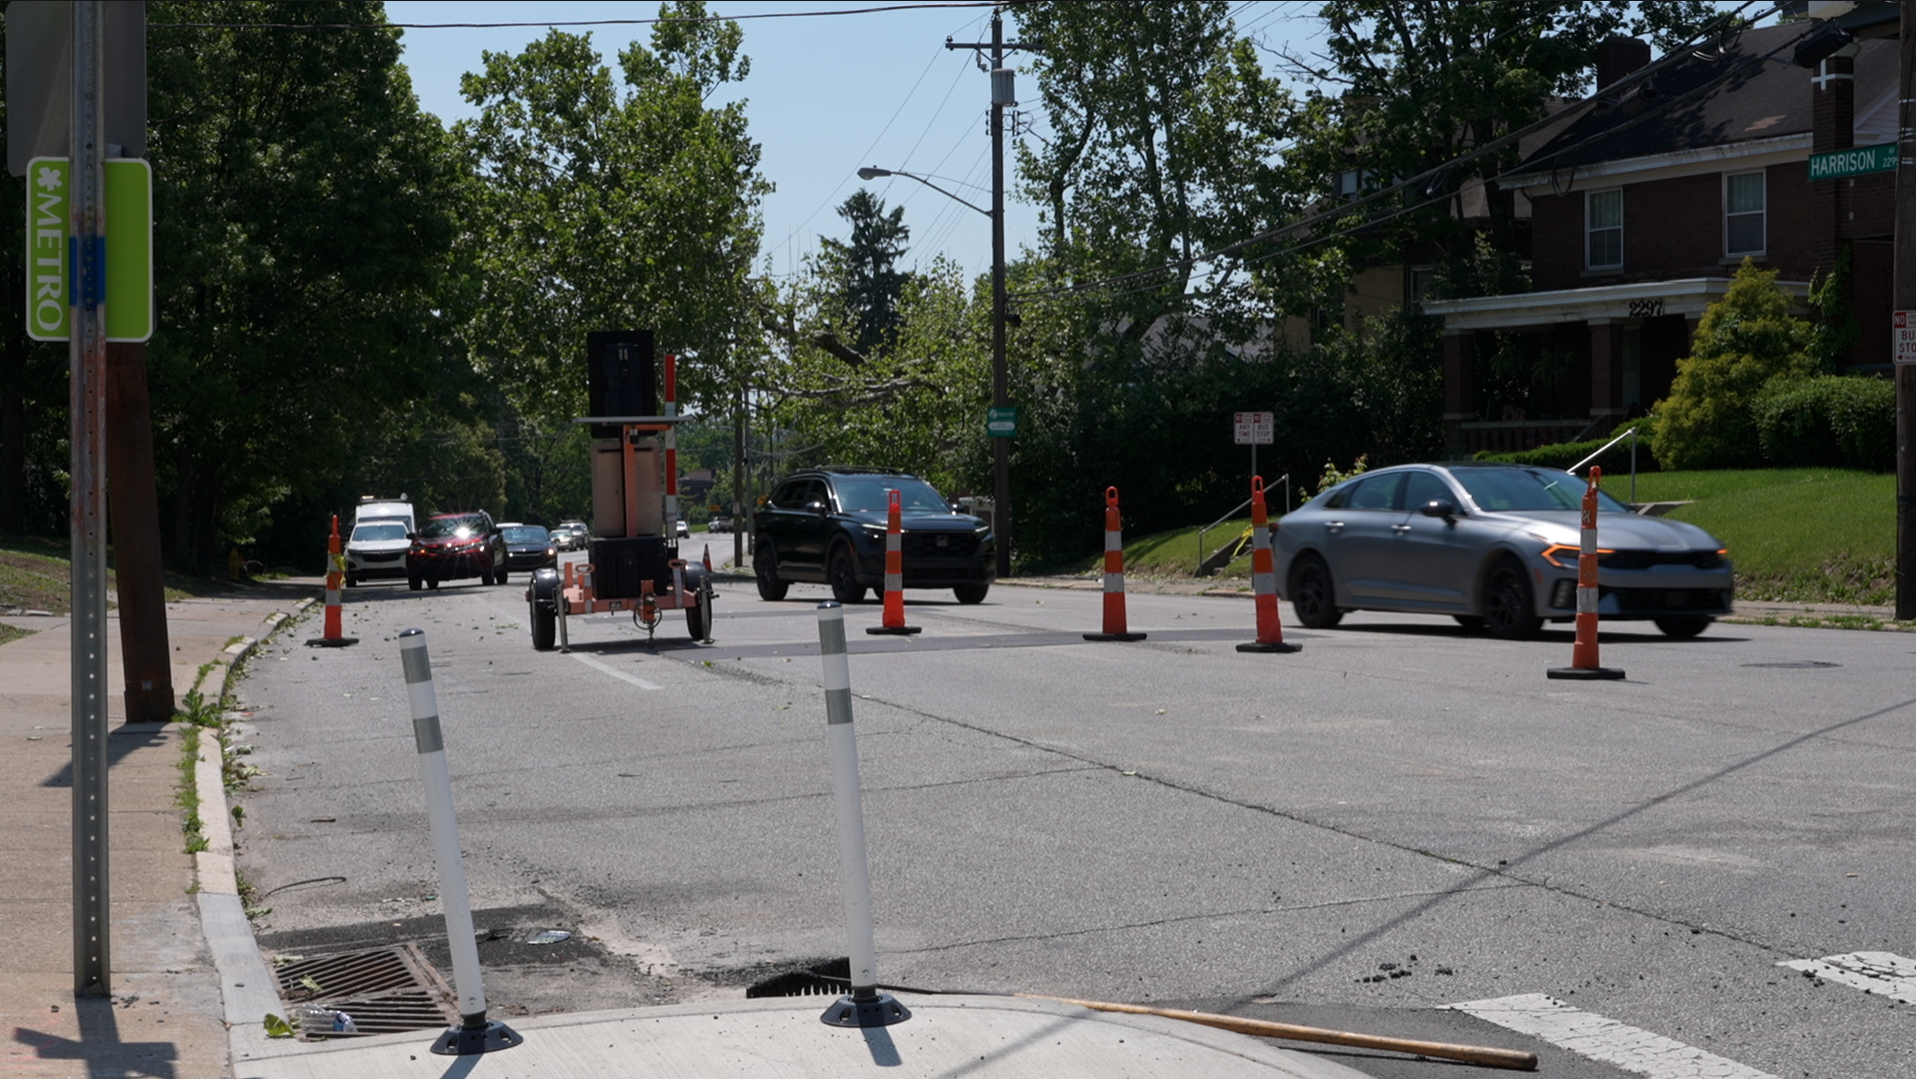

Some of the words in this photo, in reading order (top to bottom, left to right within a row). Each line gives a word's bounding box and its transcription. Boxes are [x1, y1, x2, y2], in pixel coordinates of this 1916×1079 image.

[1810, 150, 1875, 177] HARRISON
[37, 192, 63, 331] METRO
[1629, 297, 1663, 318] 2297
[1894, 315, 1906, 325] NO
[1901, 330, 1916, 341] BU
[1899, 343, 1916, 353] STO
